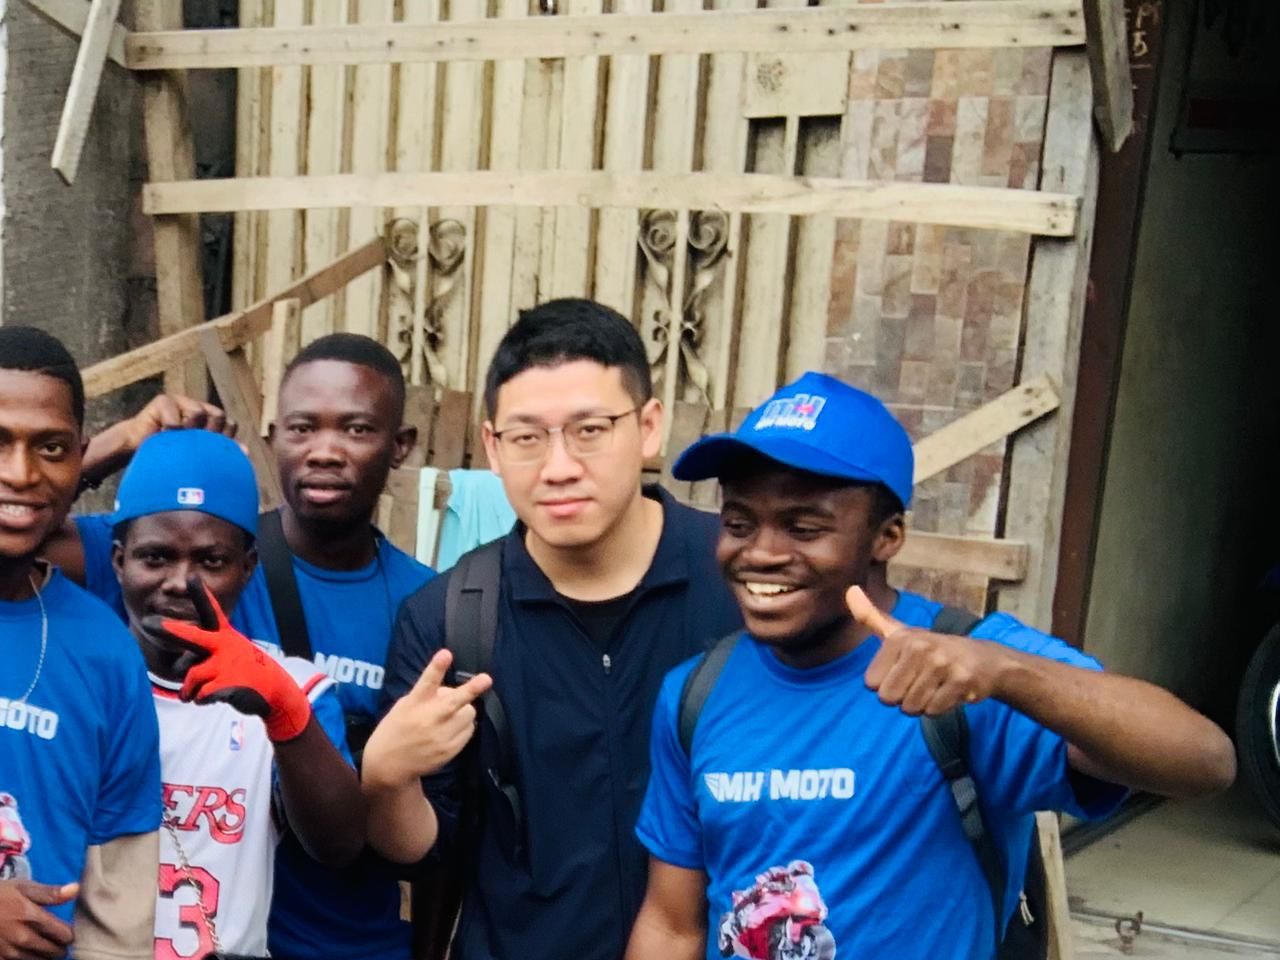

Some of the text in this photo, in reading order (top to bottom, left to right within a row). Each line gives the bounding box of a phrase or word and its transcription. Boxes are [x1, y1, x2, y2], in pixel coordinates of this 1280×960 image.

[314, 651, 385, 690] MOTO
[719, 767, 855, 803] MH MOTO
[161, 782, 247, 845] ERS
